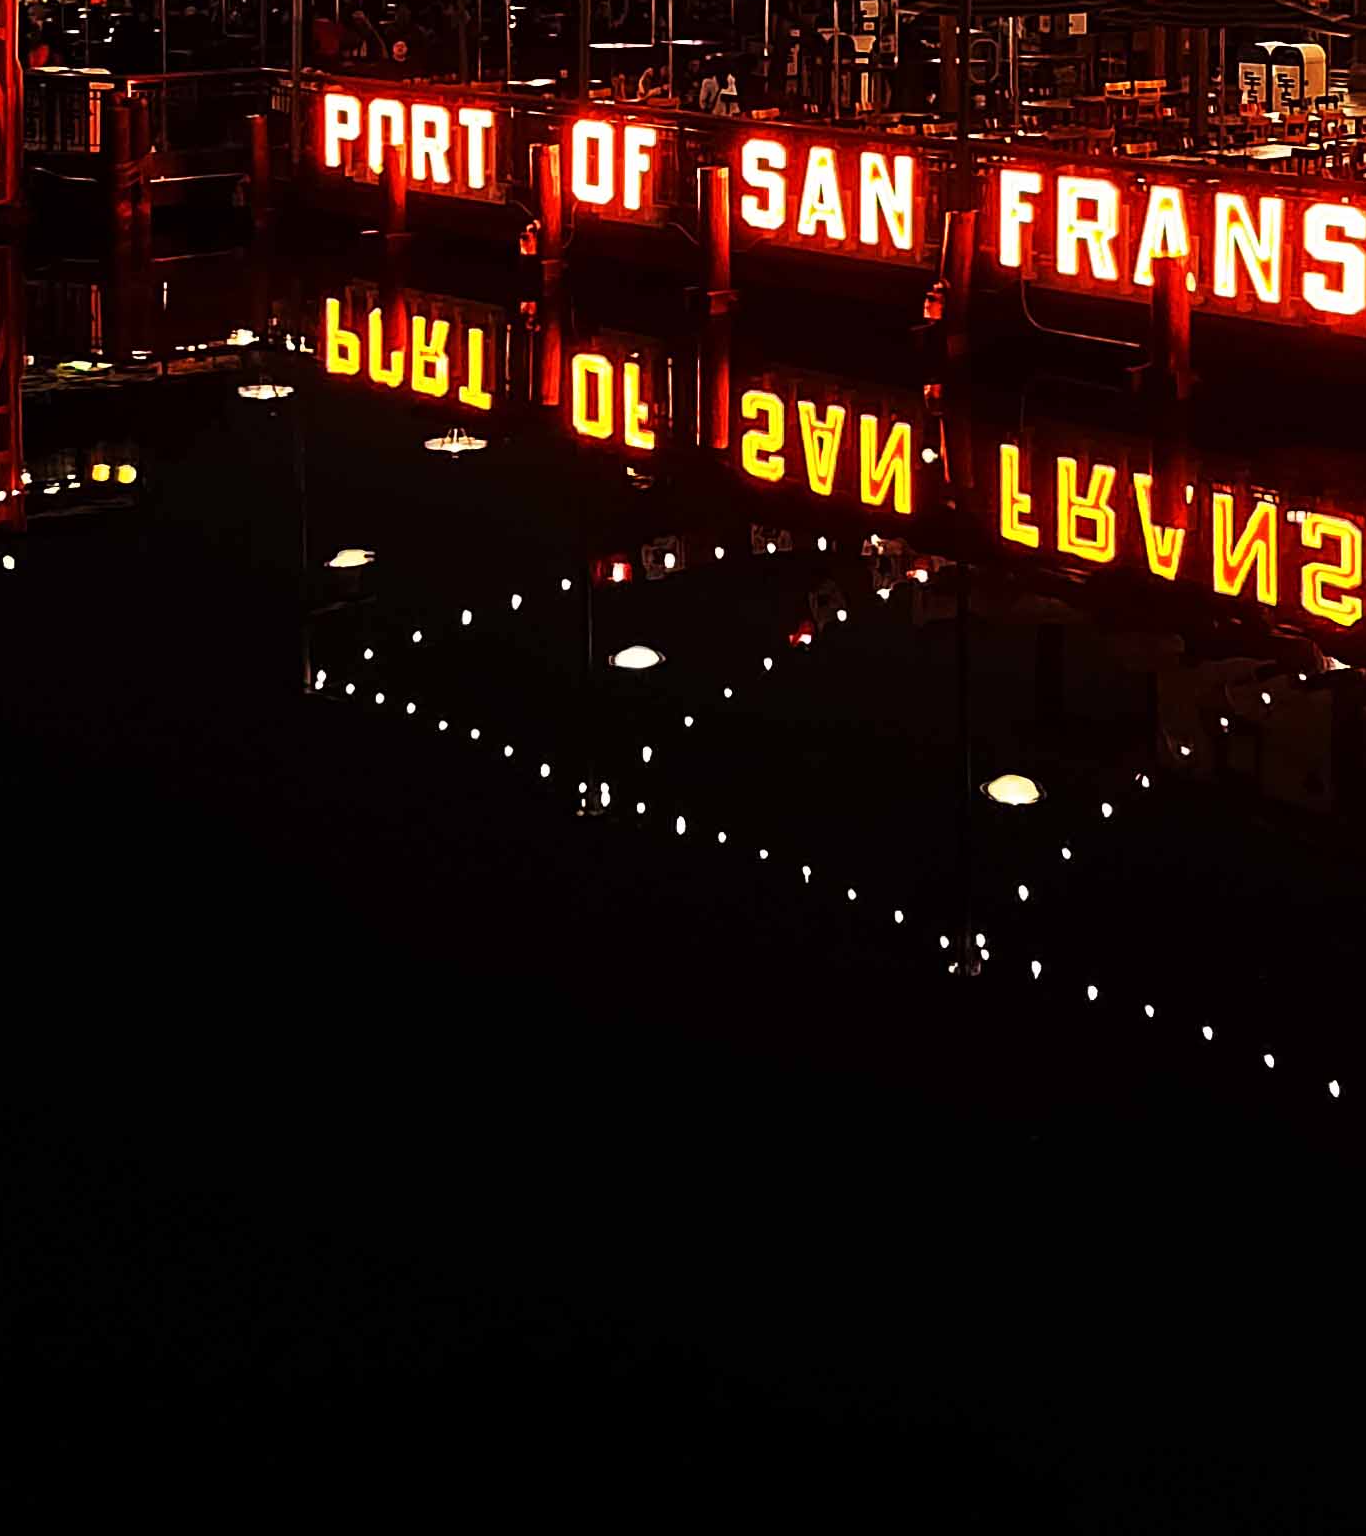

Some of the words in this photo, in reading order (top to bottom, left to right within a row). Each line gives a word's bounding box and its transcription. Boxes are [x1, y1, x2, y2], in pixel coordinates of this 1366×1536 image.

[324, 93, 494, 189] PORT
[571, 116, 657, 211] OF
[741, 139, 914, 250] SAN
